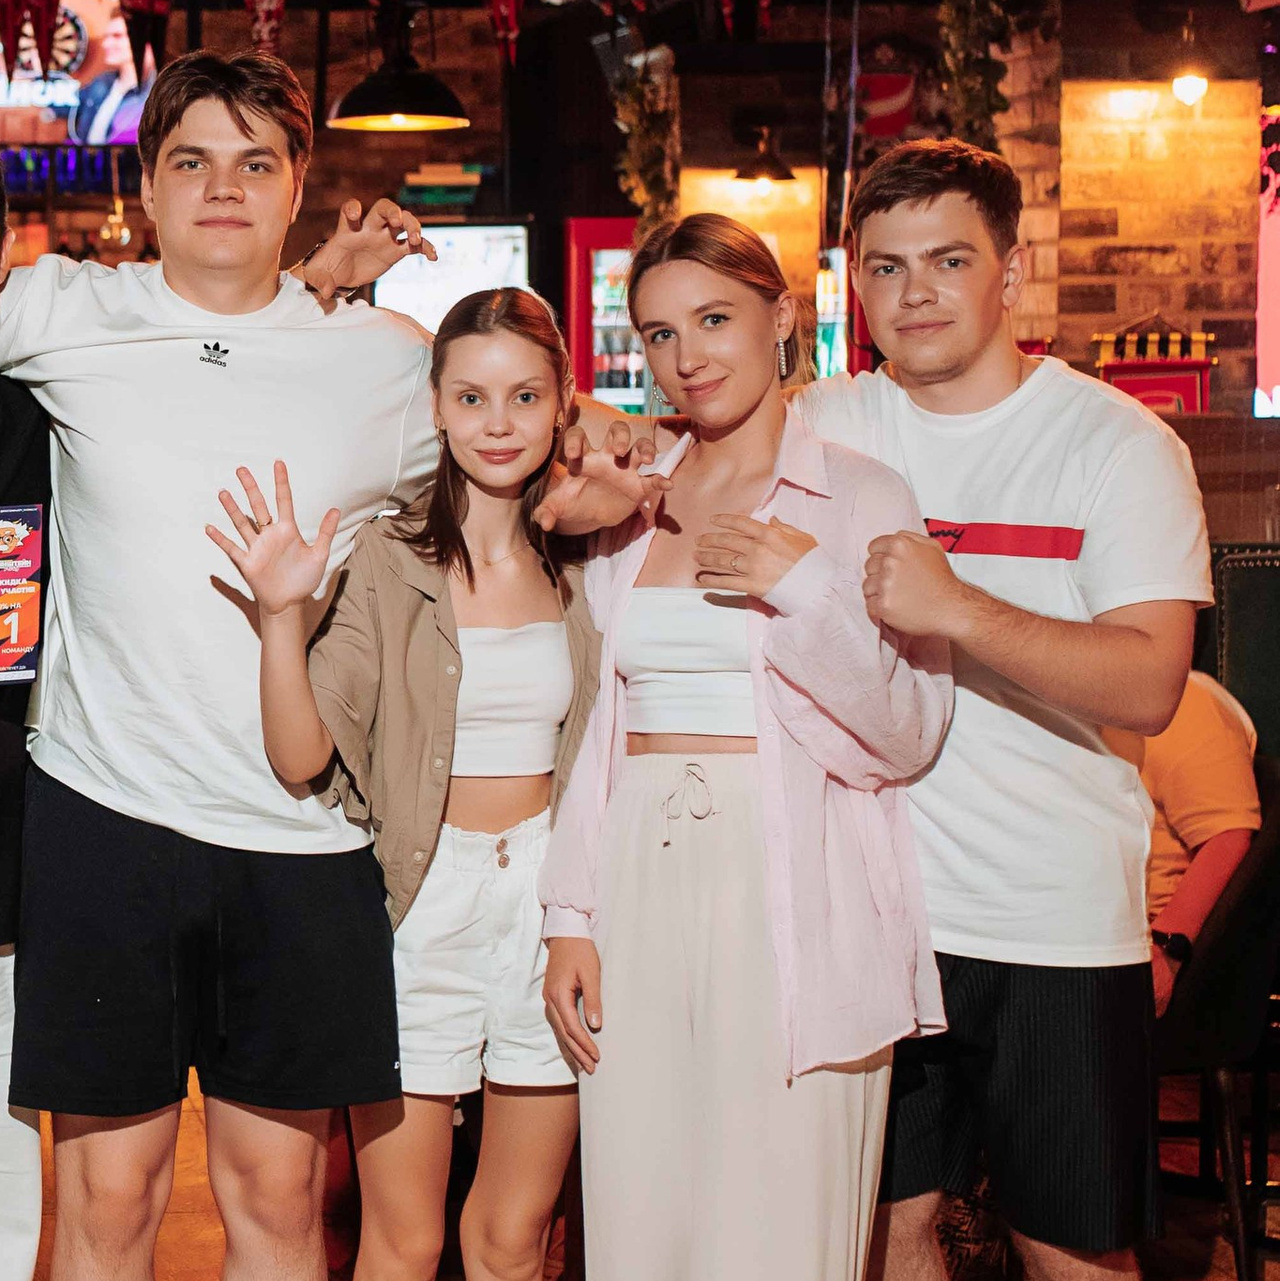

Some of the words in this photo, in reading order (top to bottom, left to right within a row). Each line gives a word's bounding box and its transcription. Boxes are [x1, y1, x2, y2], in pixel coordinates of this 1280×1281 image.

[200, 356, 227, 367] adidas
[3, 612, 19, 644] 1
[1, 646, 35, 655] КОМАНДУ
